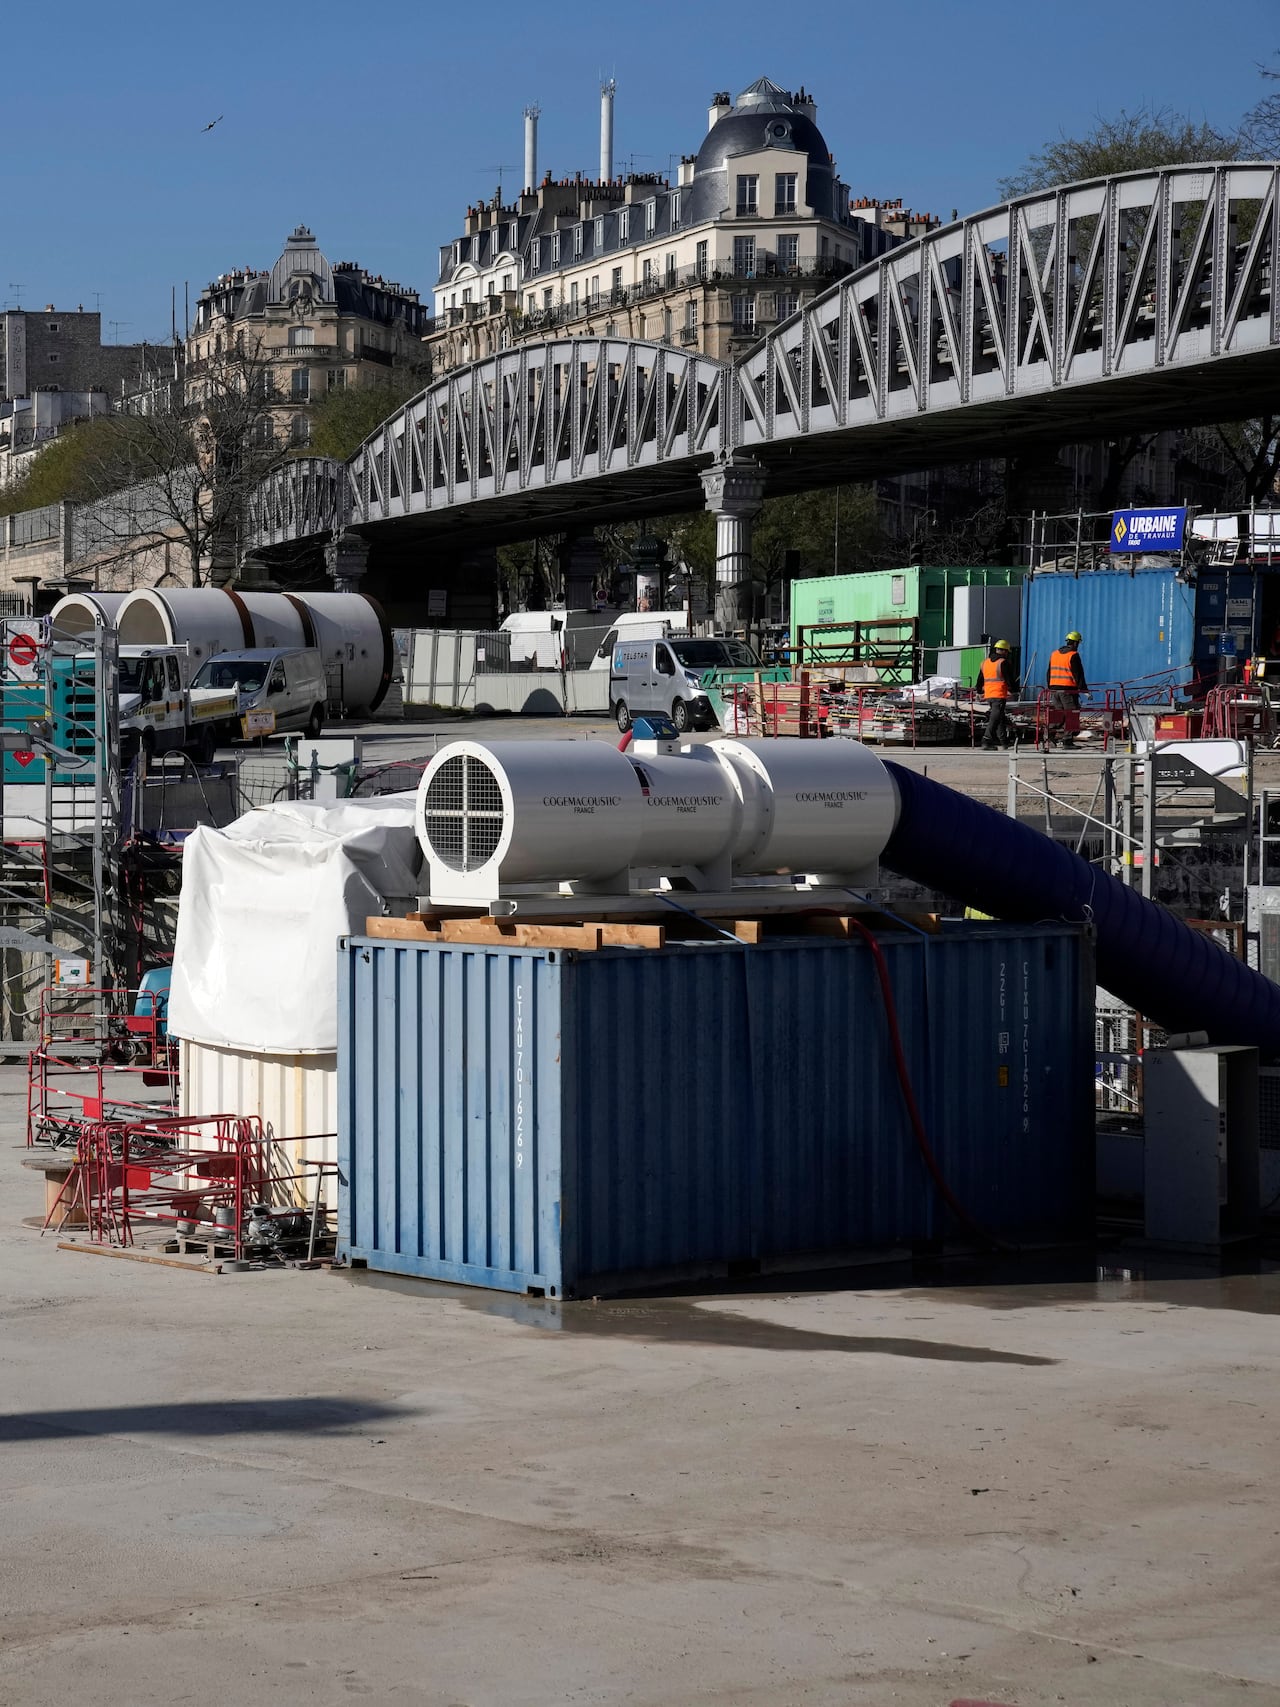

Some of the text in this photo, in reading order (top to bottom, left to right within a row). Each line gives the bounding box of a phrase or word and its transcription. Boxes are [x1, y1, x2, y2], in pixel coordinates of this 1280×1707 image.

[1130, 515, 1177, 533] URBAINE
[624, 652, 648, 660] TELSTAR
[543, 796, 621, 807] COGEMACOUSTIC
[647, 796, 722, 807] COGEMACOUSTIC
[796, 791, 868, 802] COGEMACOUSTIC
[573, 806, 595, 814] FRANCE
